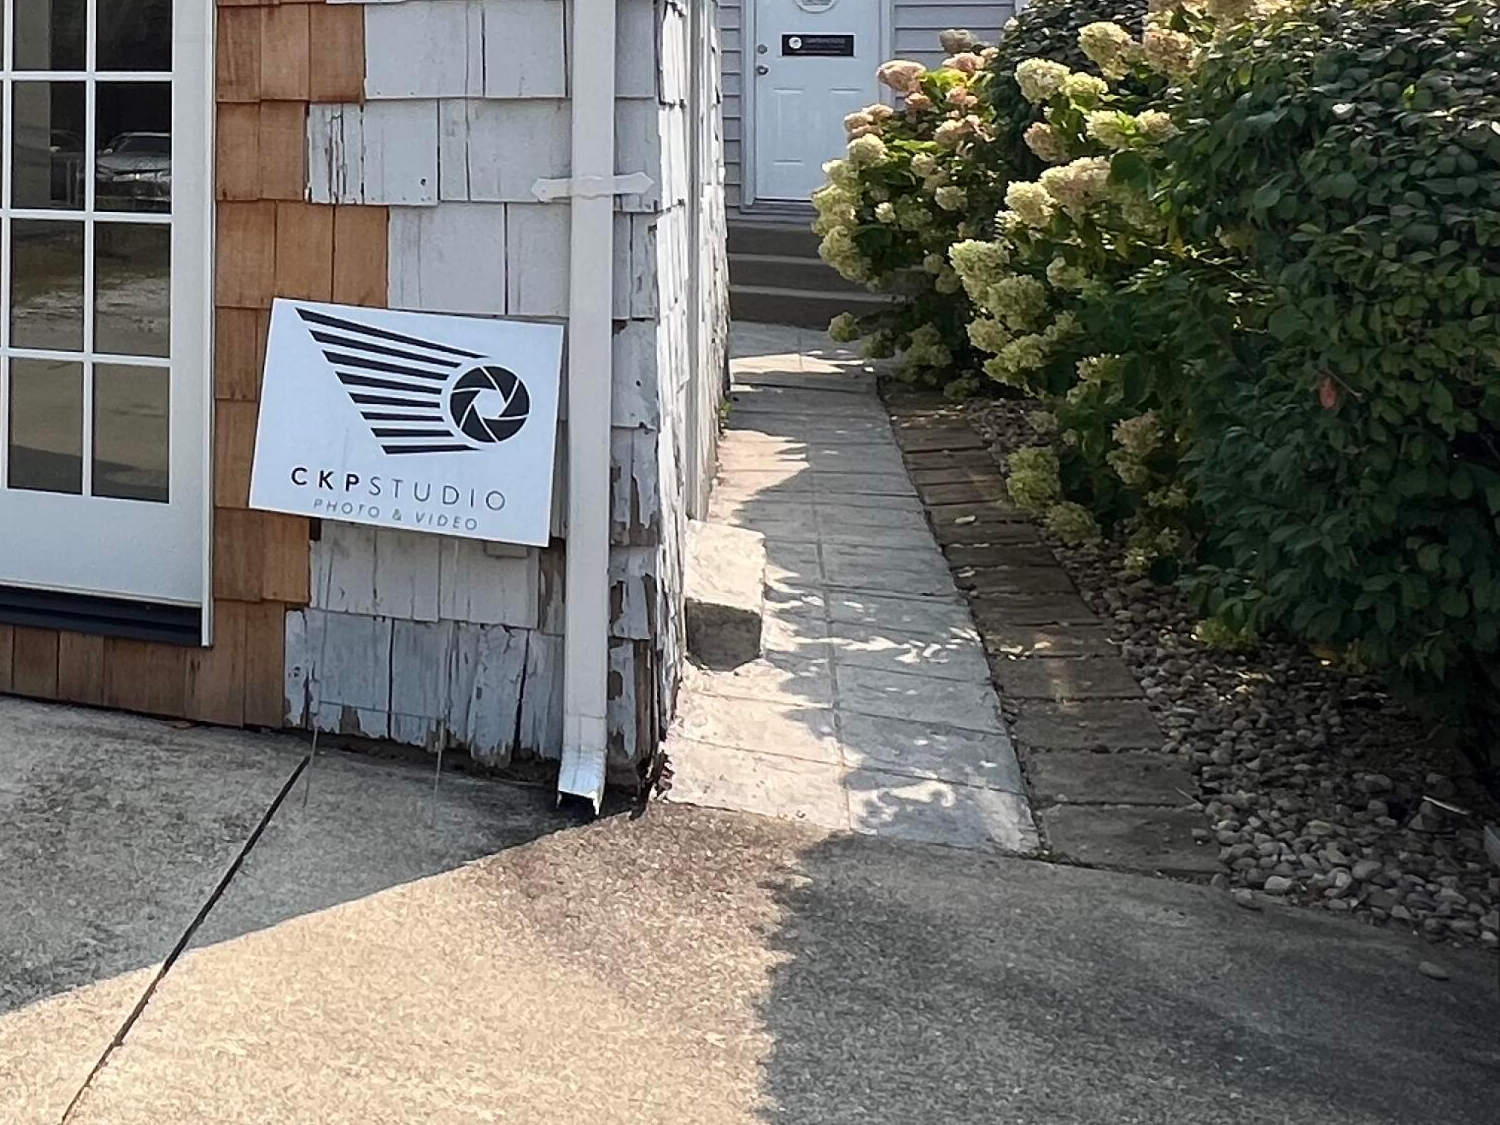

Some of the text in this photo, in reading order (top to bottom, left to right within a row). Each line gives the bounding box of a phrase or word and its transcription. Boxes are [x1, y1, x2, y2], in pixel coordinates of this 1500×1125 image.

[313, 498, 478, 531] PHOTO & VIDEO
